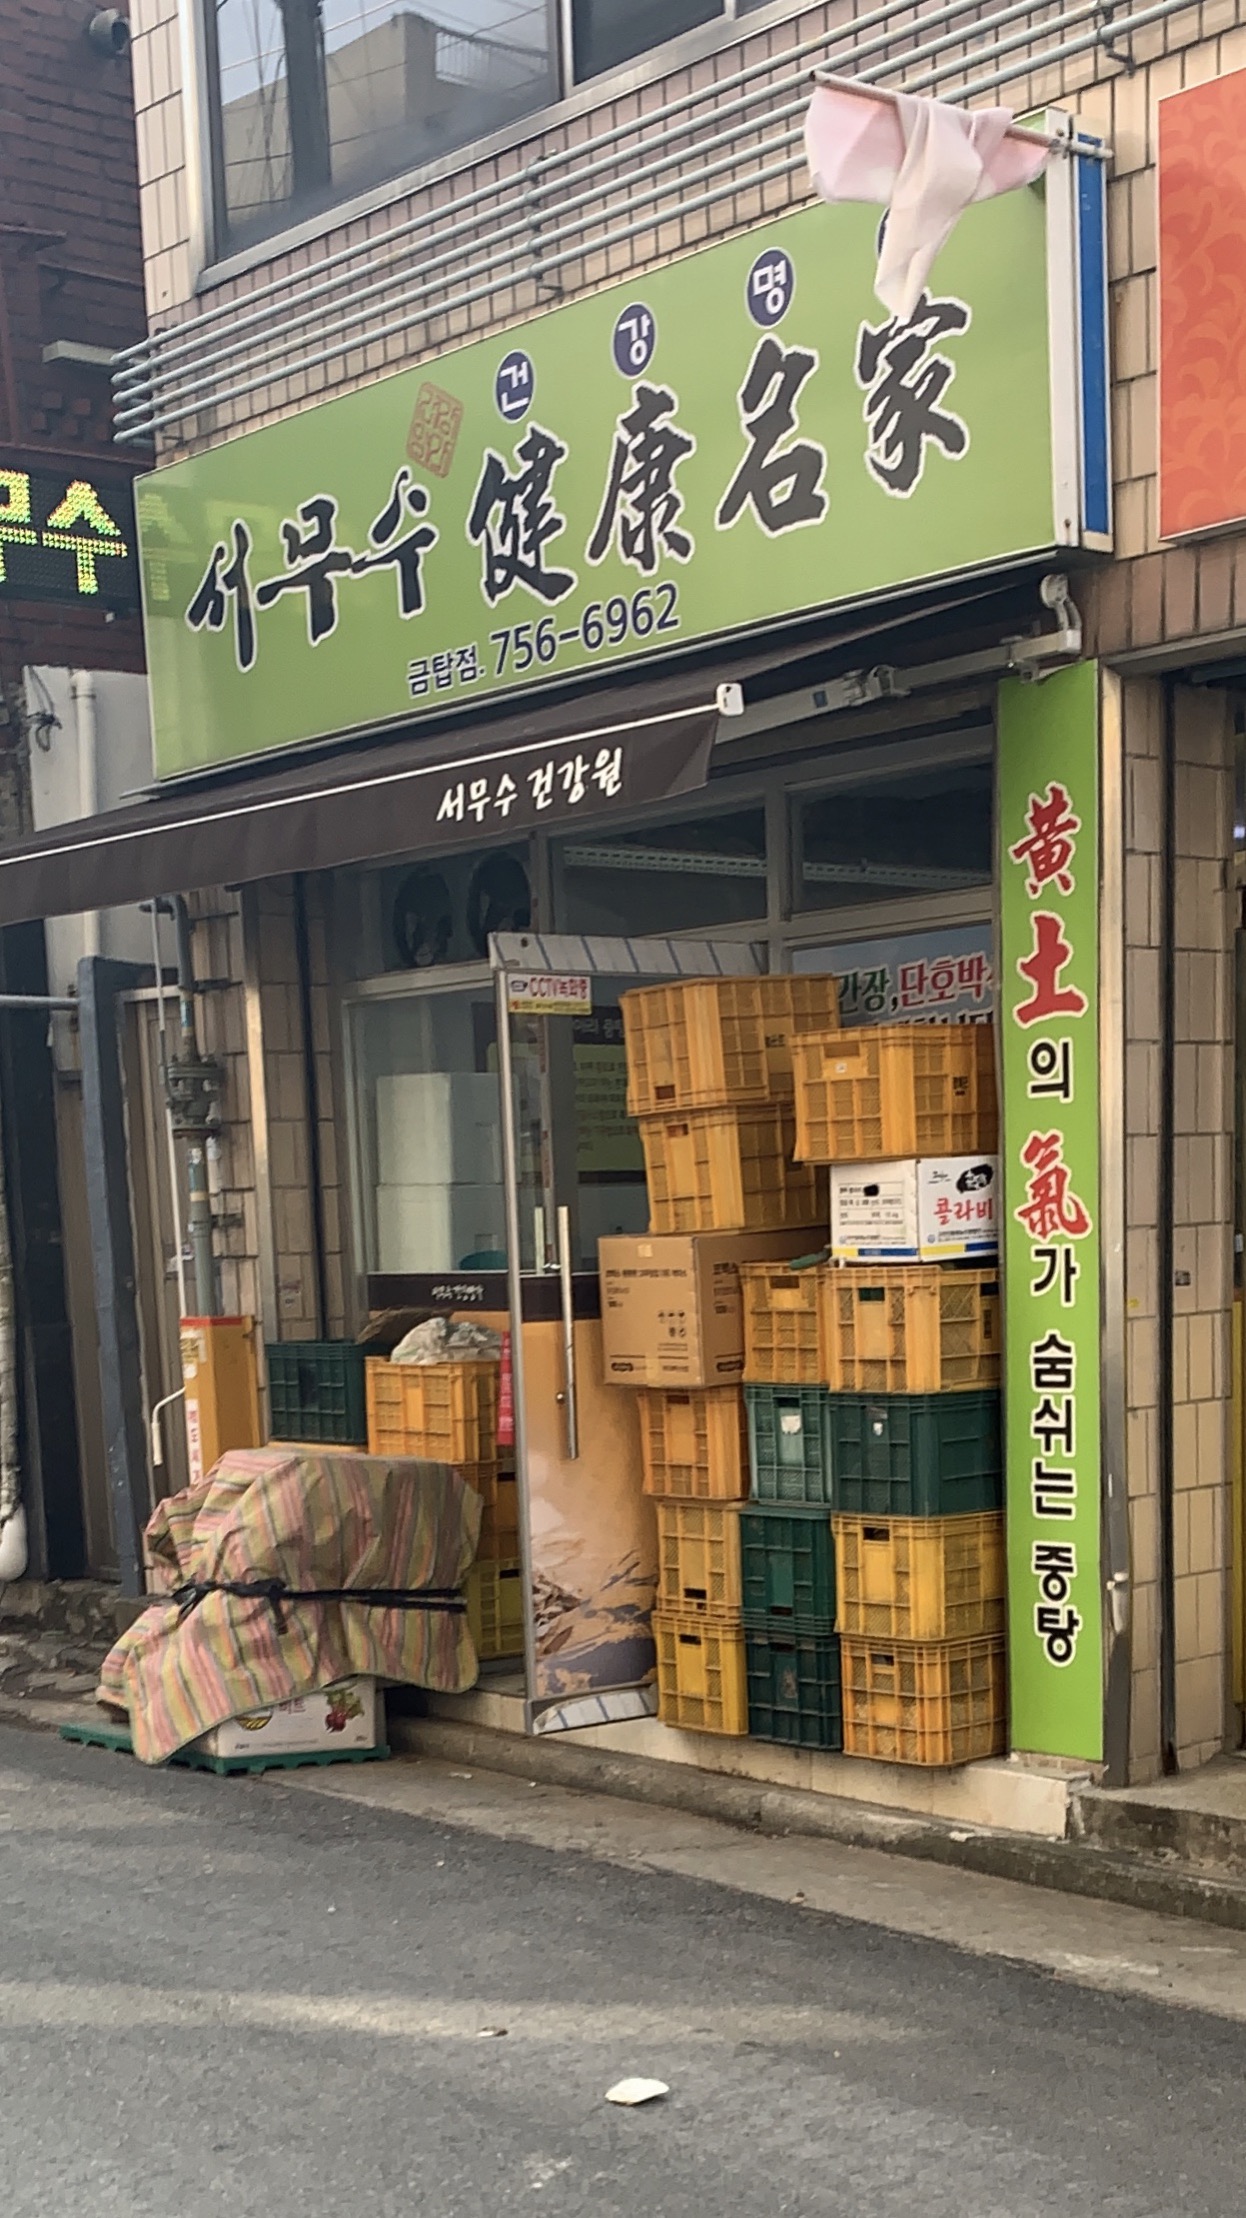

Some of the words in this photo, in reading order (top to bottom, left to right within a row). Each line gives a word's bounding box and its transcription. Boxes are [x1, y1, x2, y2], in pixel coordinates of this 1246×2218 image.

[500, 361, 530, 413] 건
[618, 313, 651, 366] 강
[752, 259, 788, 315] 명
[185, 468, 438, 671] 서무수
[407, 644, 486, 697] 금탑점.
[489, 582, 680, 675] 756-6962
[436, 773, 518, 822] 서무수
[527, 747, 622, 811] 건강원
[933, 1196, 993, 1226] 콜라비
[1032, 1333, 1074, 1516] 숨쉬는
[1033, 1544, 1081, 1664] 중탕
